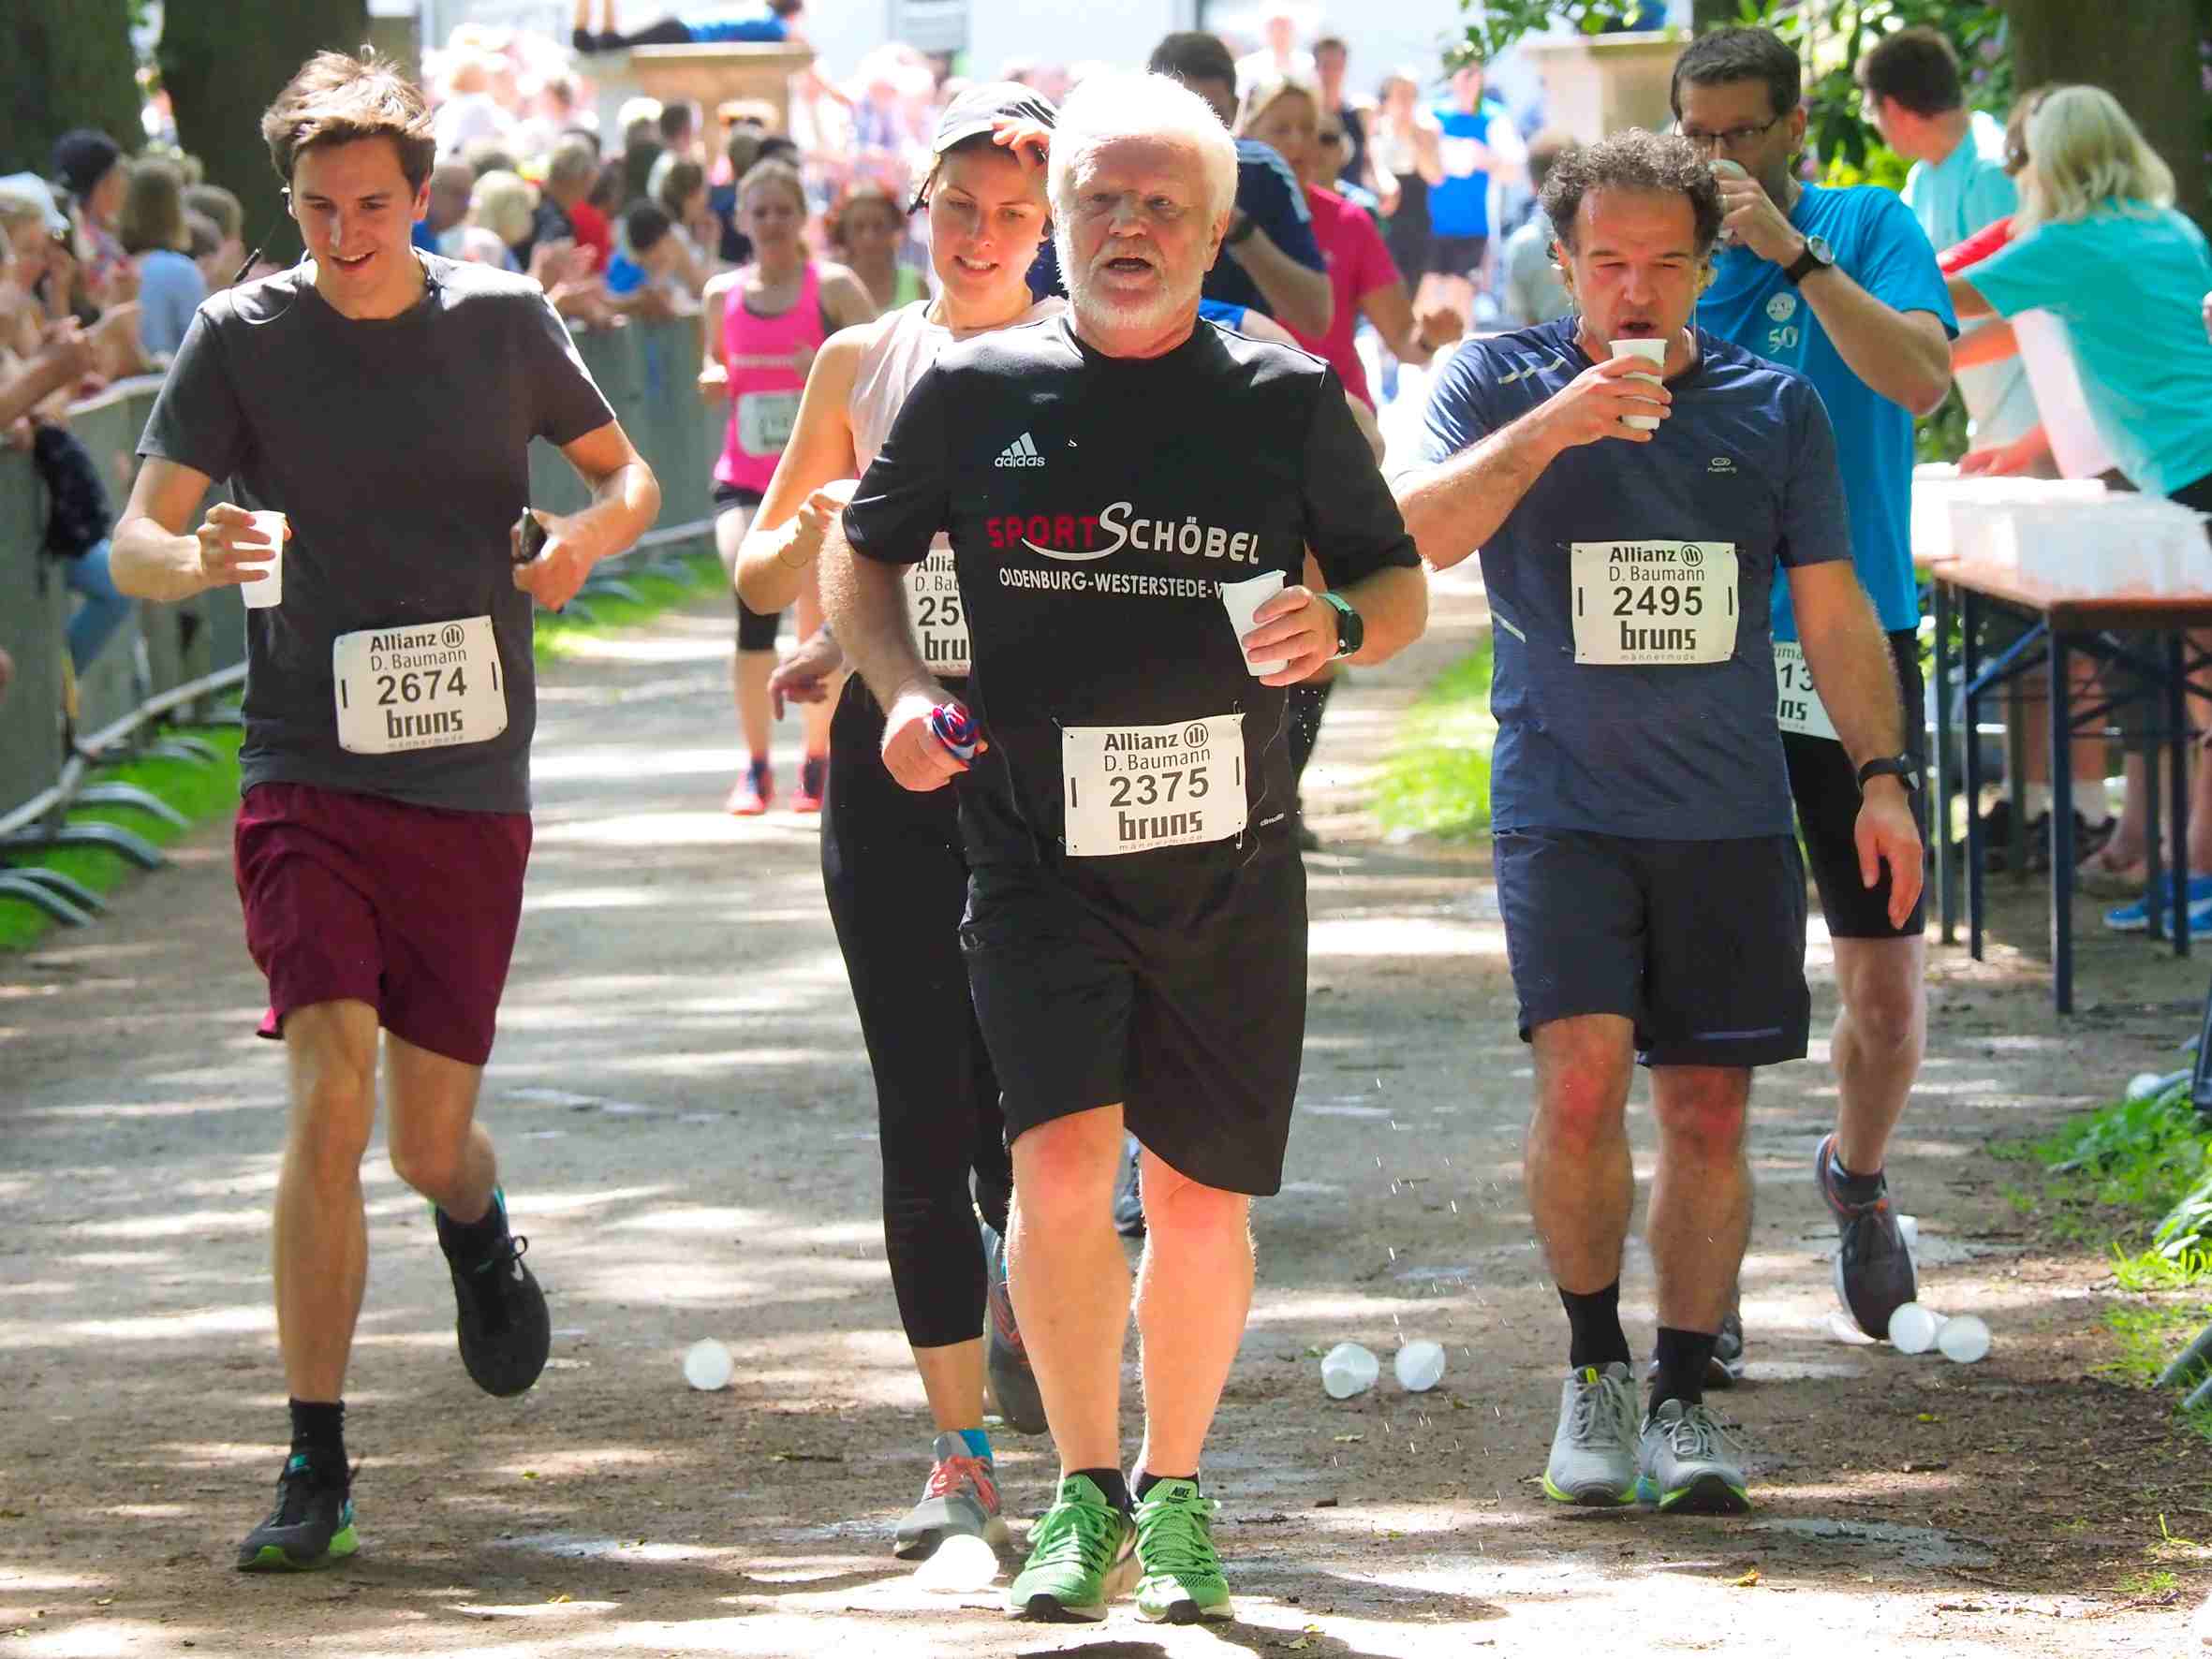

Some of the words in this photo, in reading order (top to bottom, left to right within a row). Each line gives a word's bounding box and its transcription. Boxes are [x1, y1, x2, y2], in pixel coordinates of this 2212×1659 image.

[1768, 326, 1798, 354] 50
[995, 455, 1046, 468] adidas
[1609, 547, 1677, 563] Allianz
[915, 576, 929, 592] D.
[1610, 566, 1625, 581] D.
[1630, 565, 1704, 581] Baumann
[918, 596, 960, 626] 25
[1613, 585, 1703, 616] 2495
[370, 632, 436, 653] Allianz
[924, 631, 966, 661] bru
[1621, 621, 1696, 651] bruns
[371, 654, 388, 671] D.
[392, 649, 467, 668] Baumann
[376, 667, 467, 706] 2674
[387, 709, 464, 739] bruns
[1104, 733, 1178, 751] Allianz
[1105, 755, 1123, 771] D.
[1128, 749, 1210, 771] Baumann
[1110, 767, 1209, 807] 2375
[1119, 811, 1202, 841] bruns
